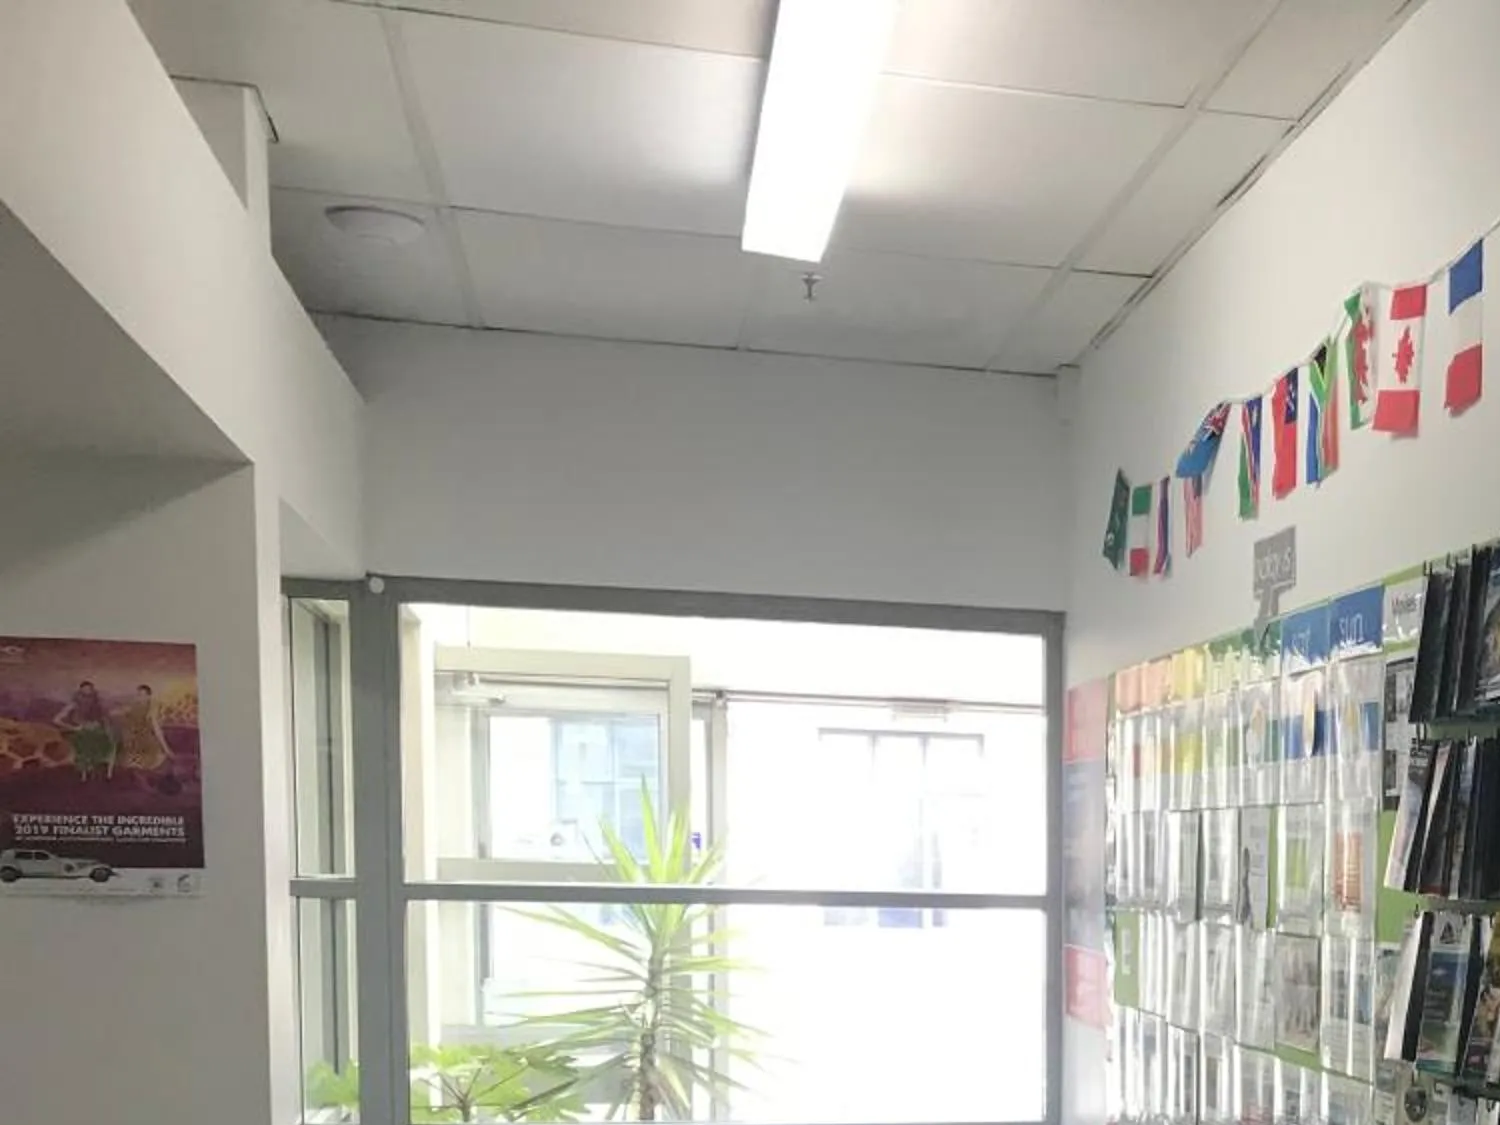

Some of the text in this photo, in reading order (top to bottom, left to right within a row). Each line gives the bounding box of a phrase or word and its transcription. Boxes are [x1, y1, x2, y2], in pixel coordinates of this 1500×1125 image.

[13, 815, 184, 826] EXPERIENCE THE INCREDIBLE
[15, 825, 186, 837] 2019 FINALIST GARMENTS
